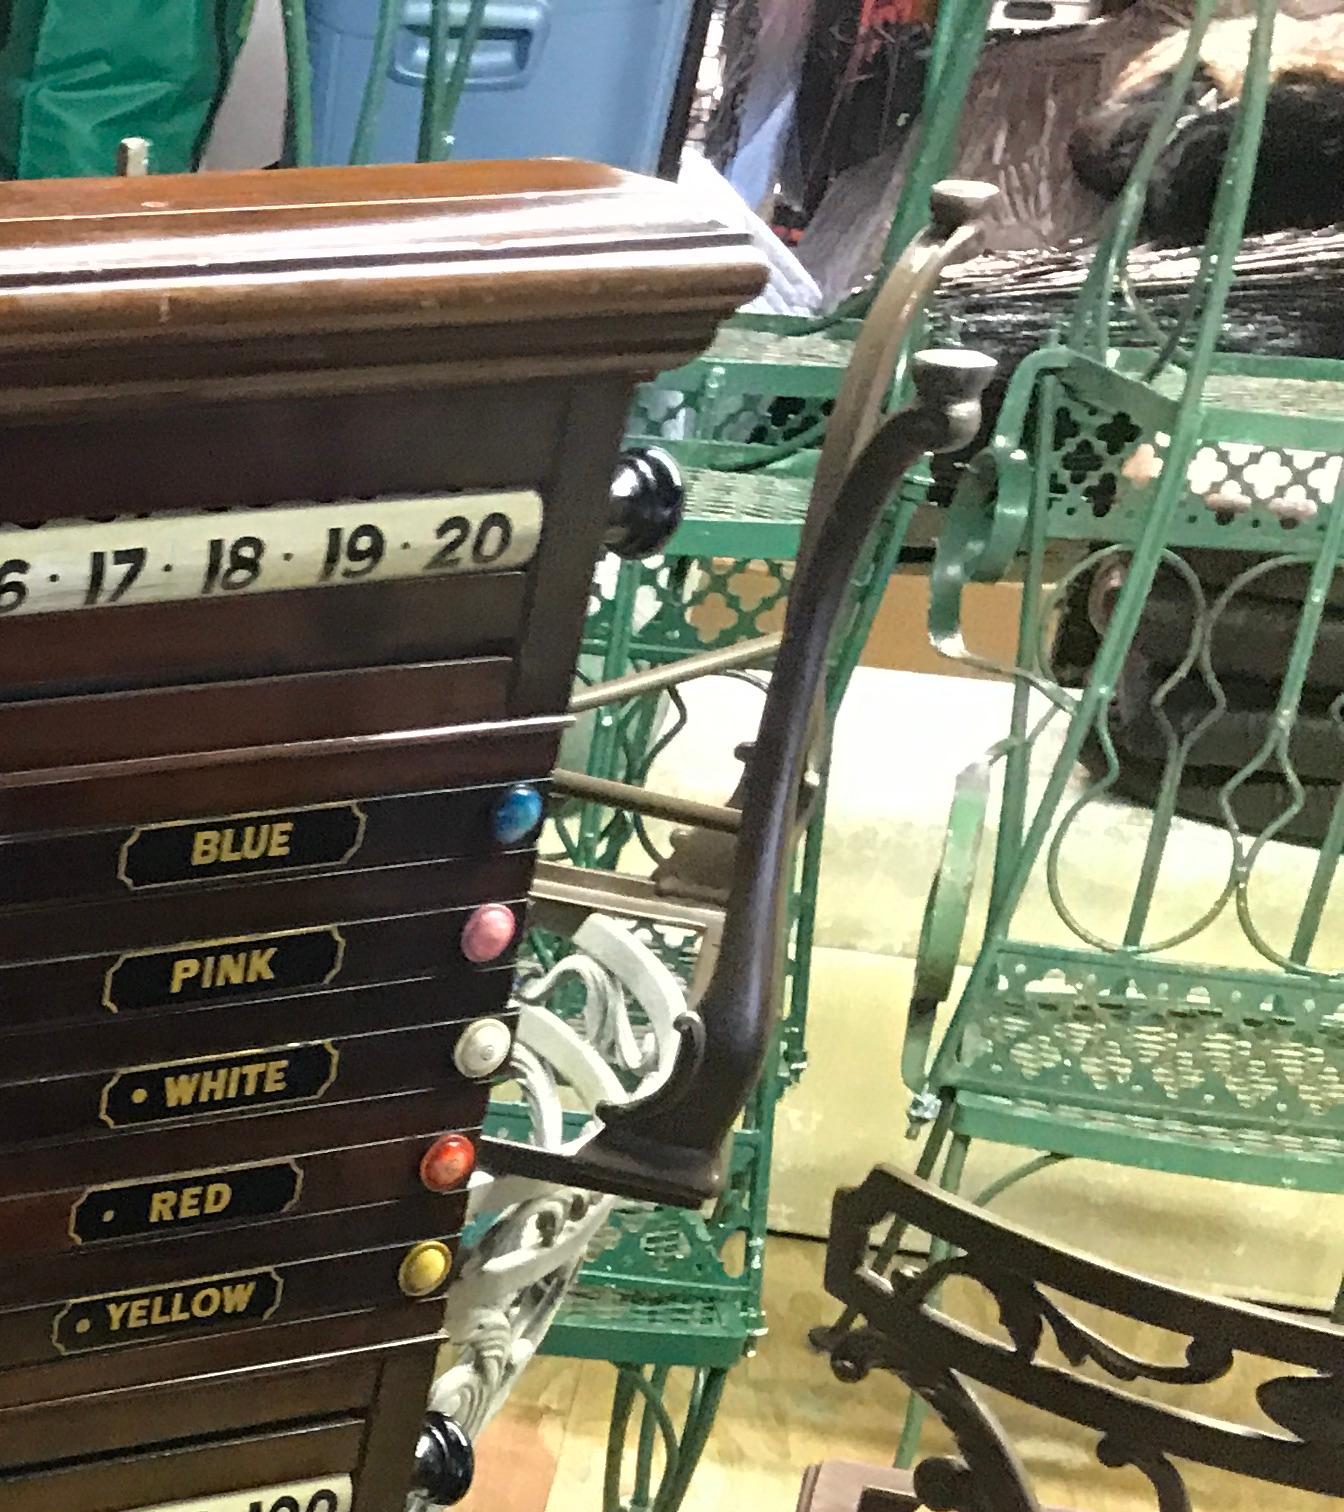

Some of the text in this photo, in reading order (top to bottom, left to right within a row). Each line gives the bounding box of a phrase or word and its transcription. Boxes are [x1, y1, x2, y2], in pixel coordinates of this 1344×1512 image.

[84, 547, 148, 606] 17
[202, 536, 265, 594] 18
[318, 523, 386, 582] 19
[422, 512, 513, 571] 20
[191, 822, 294, 866] BLUE
[170, 948, 279, 994] PINK
[164, 1060, 290, 1108] WHITE
[148, 1182, 233, 1223] RED
[107, 1282, 257, 1331] YELLOW
